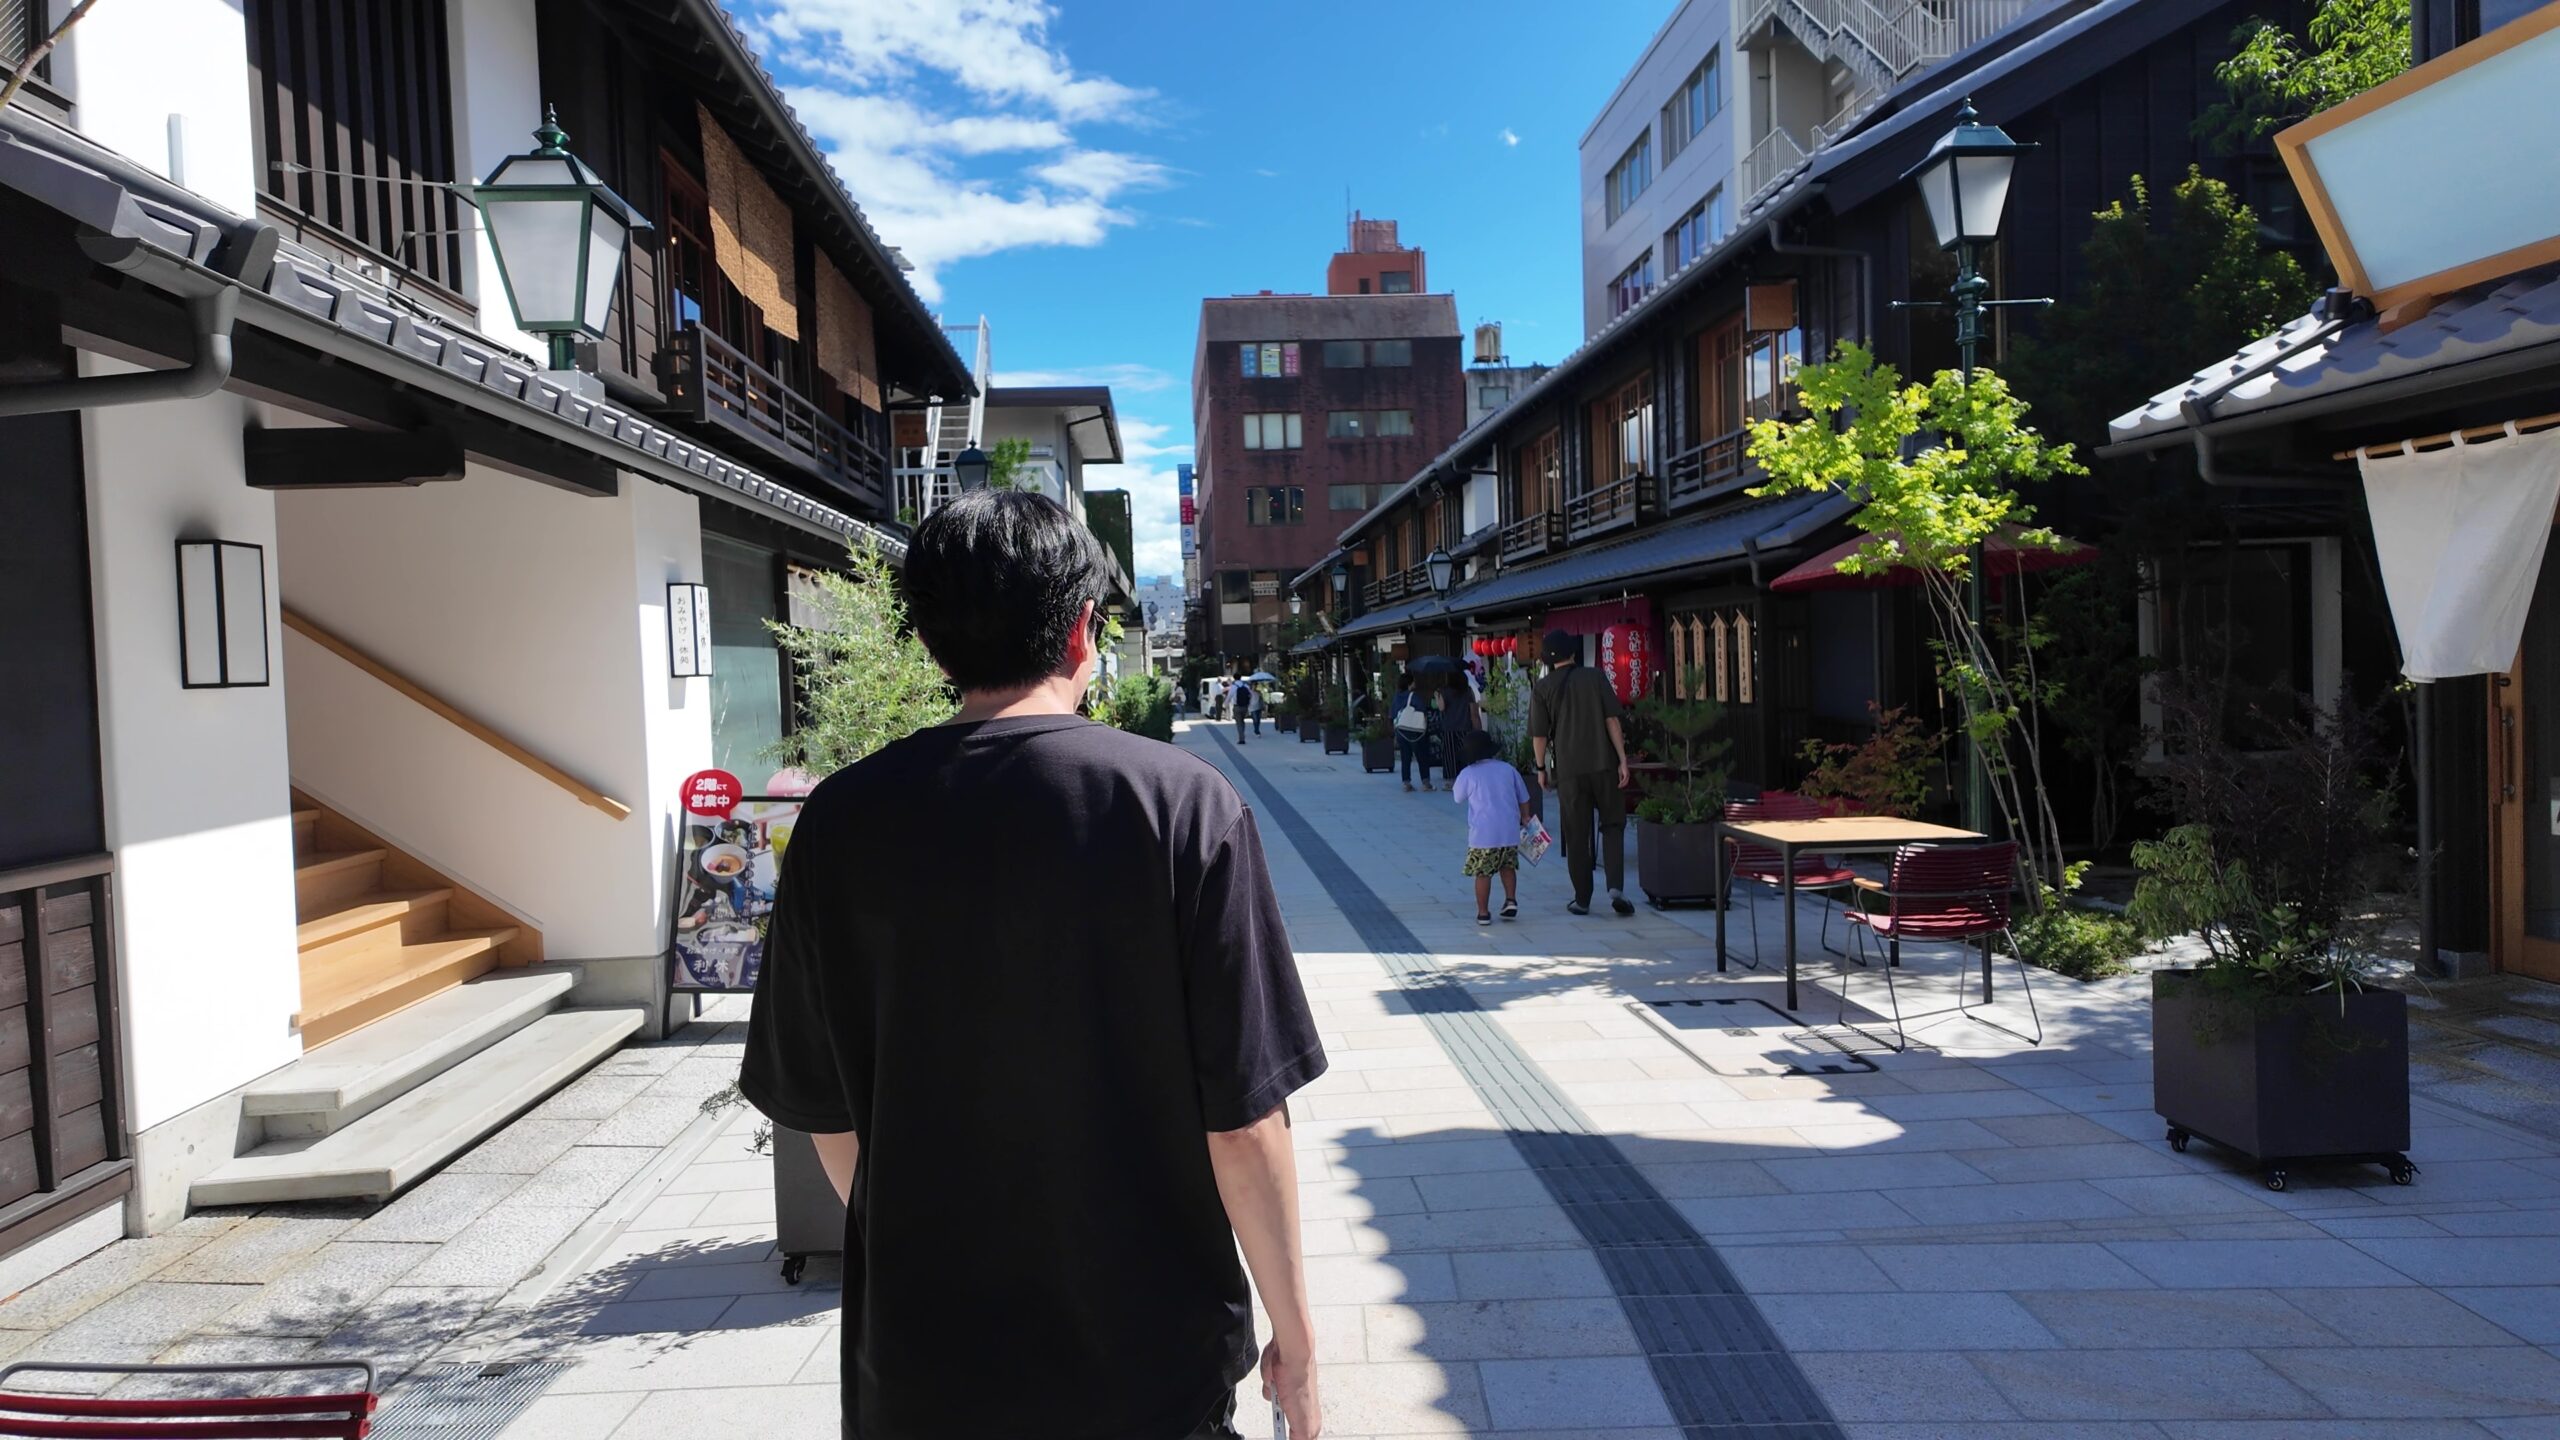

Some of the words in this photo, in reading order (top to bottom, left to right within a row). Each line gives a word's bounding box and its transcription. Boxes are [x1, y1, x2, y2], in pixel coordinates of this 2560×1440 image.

[1628, 630, 1641, 697] そば・ほうとう
[695, 778, 728, 791] 2階にて
[691, 794, 730, 808] 営業中
[693, 959, 729, 974] 利休
